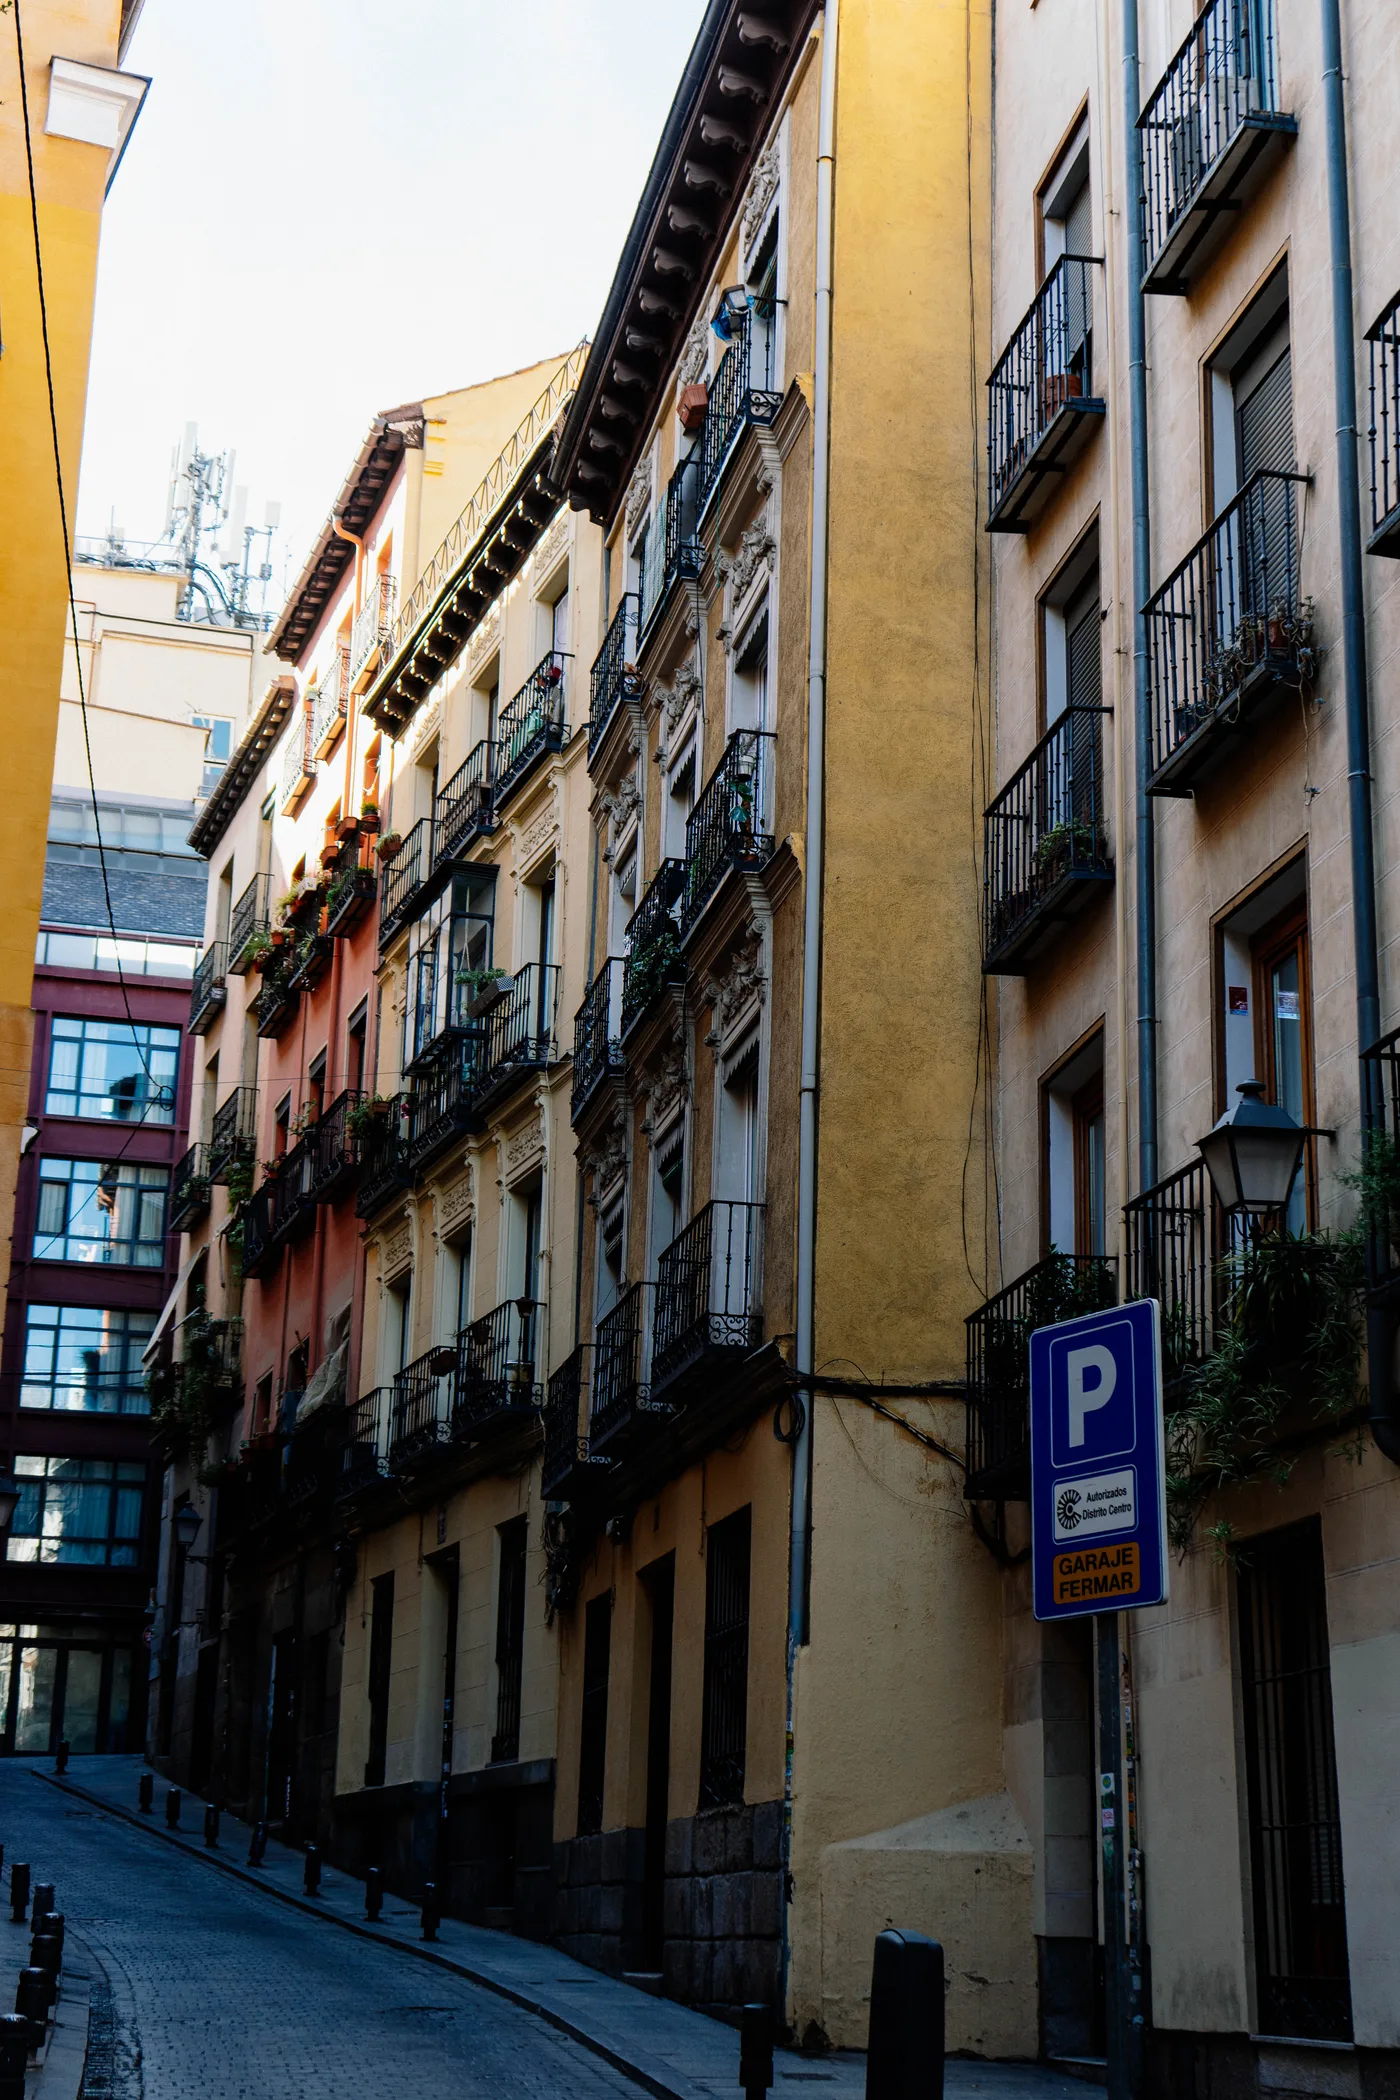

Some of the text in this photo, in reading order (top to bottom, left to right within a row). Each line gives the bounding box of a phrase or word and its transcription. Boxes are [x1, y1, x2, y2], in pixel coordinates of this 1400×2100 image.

[1067, 1344, 1117, 1448] P
[1086, 1486, 1127, 1503] Autorizados
[1082, 1502, 1132, 1520] Distrito Centro
[1059, 1547, 1134, 1576] GARAJE
[1060, 1571, 1134, 1599] FERMAR
